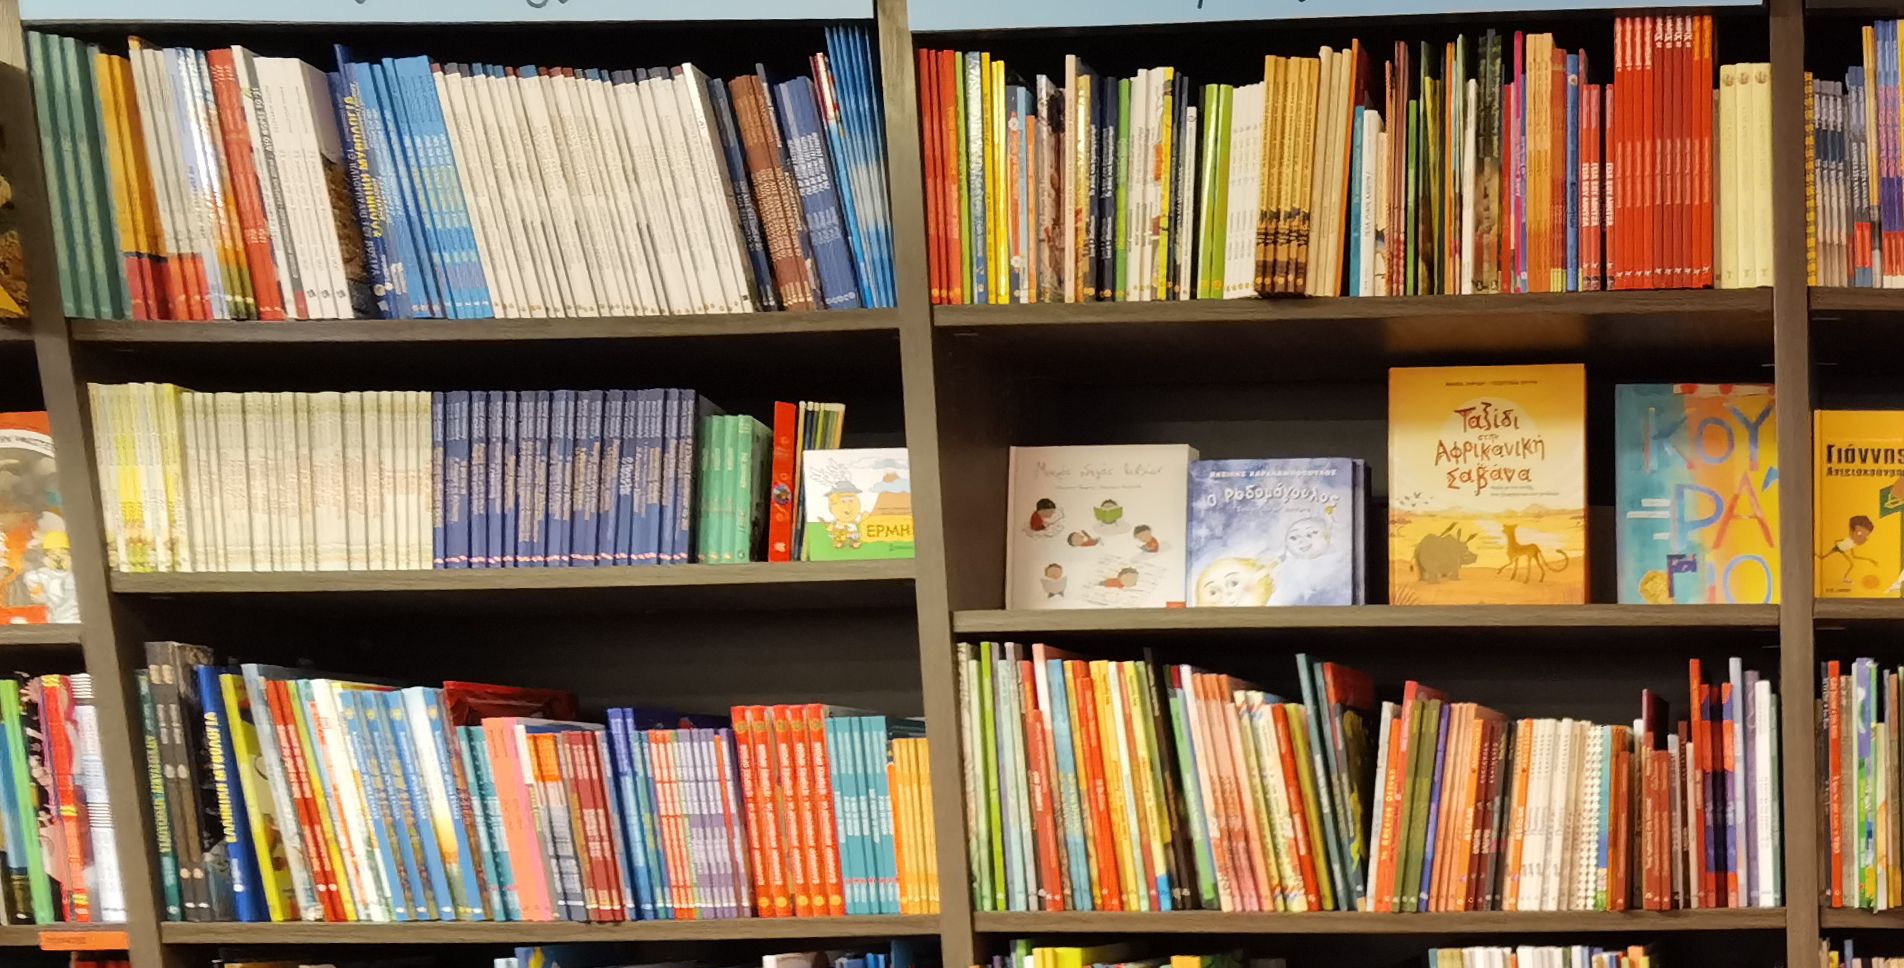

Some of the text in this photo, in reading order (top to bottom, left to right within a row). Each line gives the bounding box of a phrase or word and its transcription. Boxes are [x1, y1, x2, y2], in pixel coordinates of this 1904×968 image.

[1454, 402, 1520, 432] Ταξίδι
[1434, 435, 1545, 466] Αφρικανική
[204, 711, 238, 843] ΕΛΛΗΝΙΚΗ ΜΥΘΟΛΟΓΙΑ
